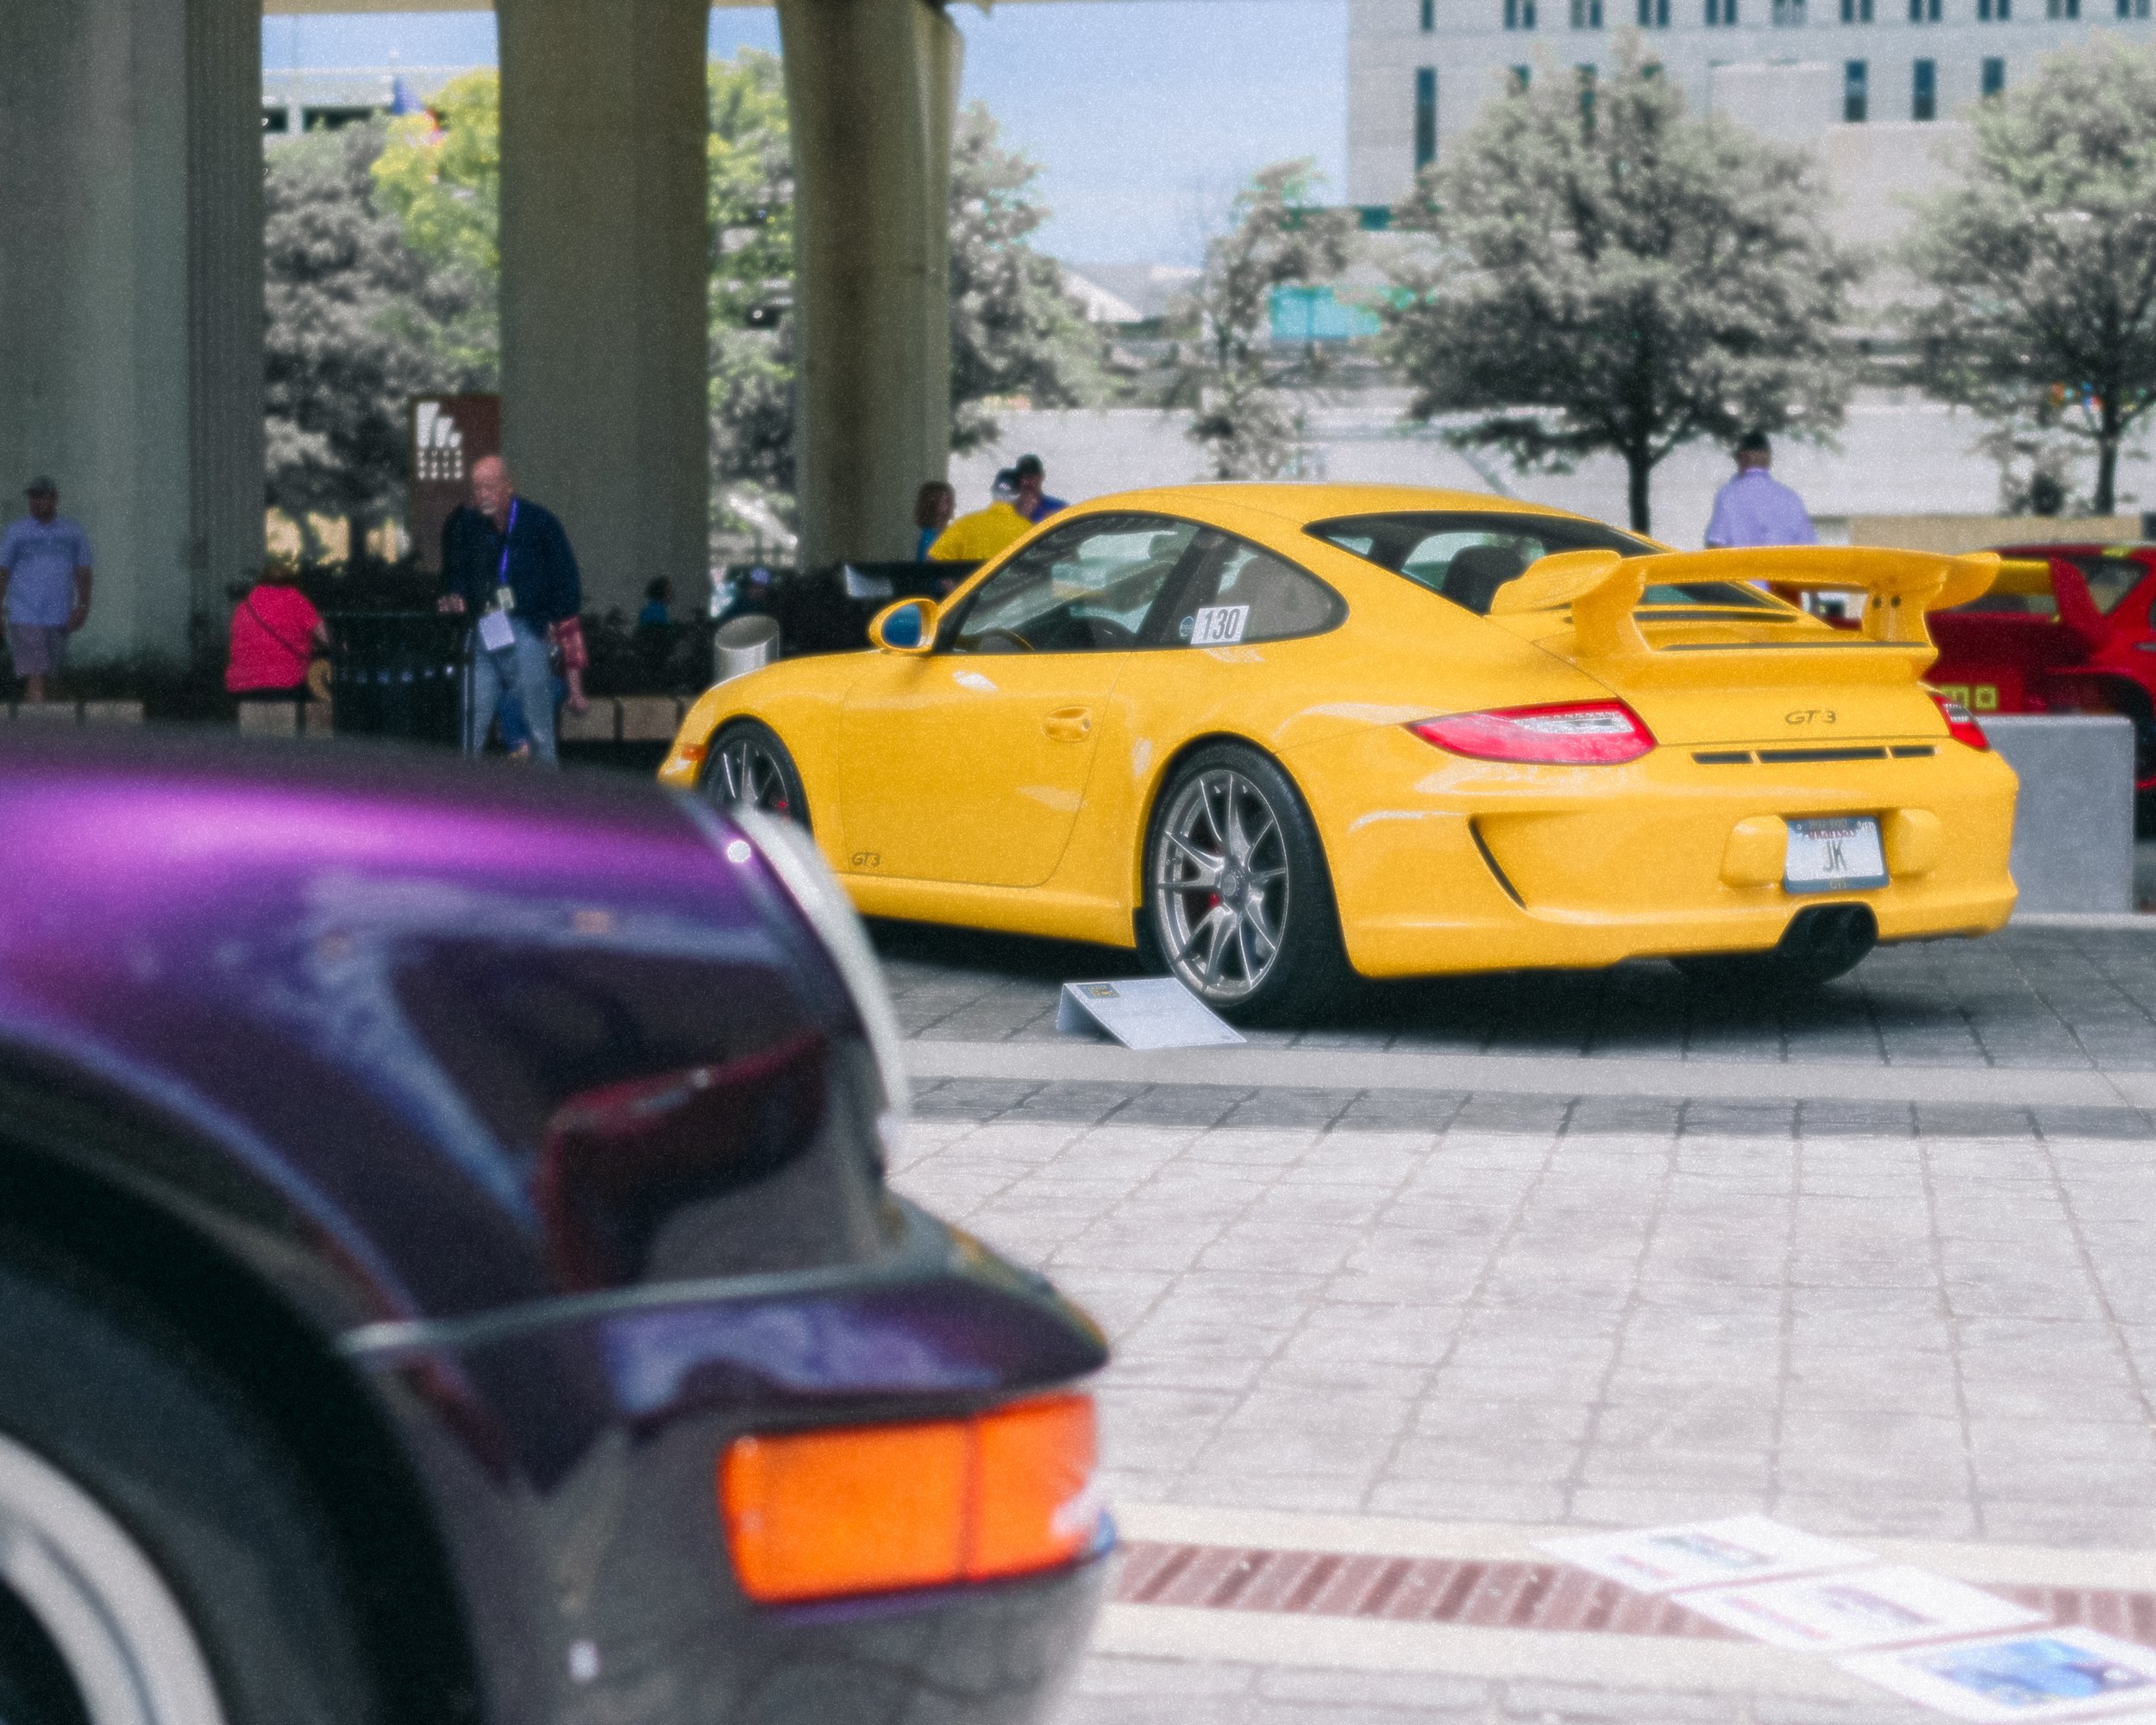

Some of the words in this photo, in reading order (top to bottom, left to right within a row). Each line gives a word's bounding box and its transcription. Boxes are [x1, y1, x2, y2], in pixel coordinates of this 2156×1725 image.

[1202, 608, 1240, 639] 130
[851, 851, 881, 867] GT3
[1822, 839, 1847, 871] JK
